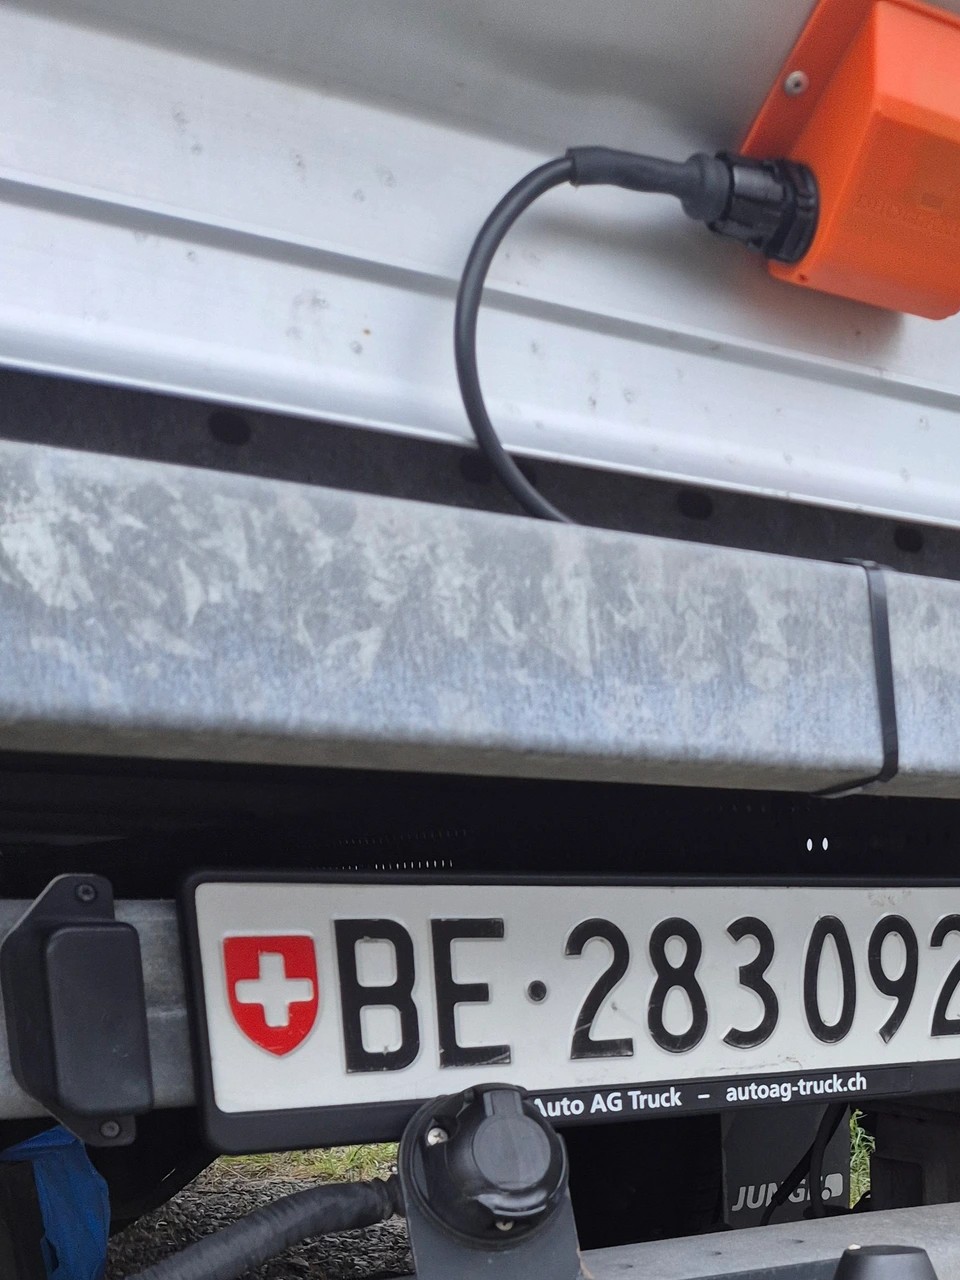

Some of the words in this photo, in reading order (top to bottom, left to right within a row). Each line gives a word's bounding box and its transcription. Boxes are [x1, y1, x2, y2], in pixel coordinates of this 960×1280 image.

[589, 1091, 623, 1114] AG
[627, 1086, 683, 1110] Truck
[725, 1071, 868, 1102] autoag-truck.ch
